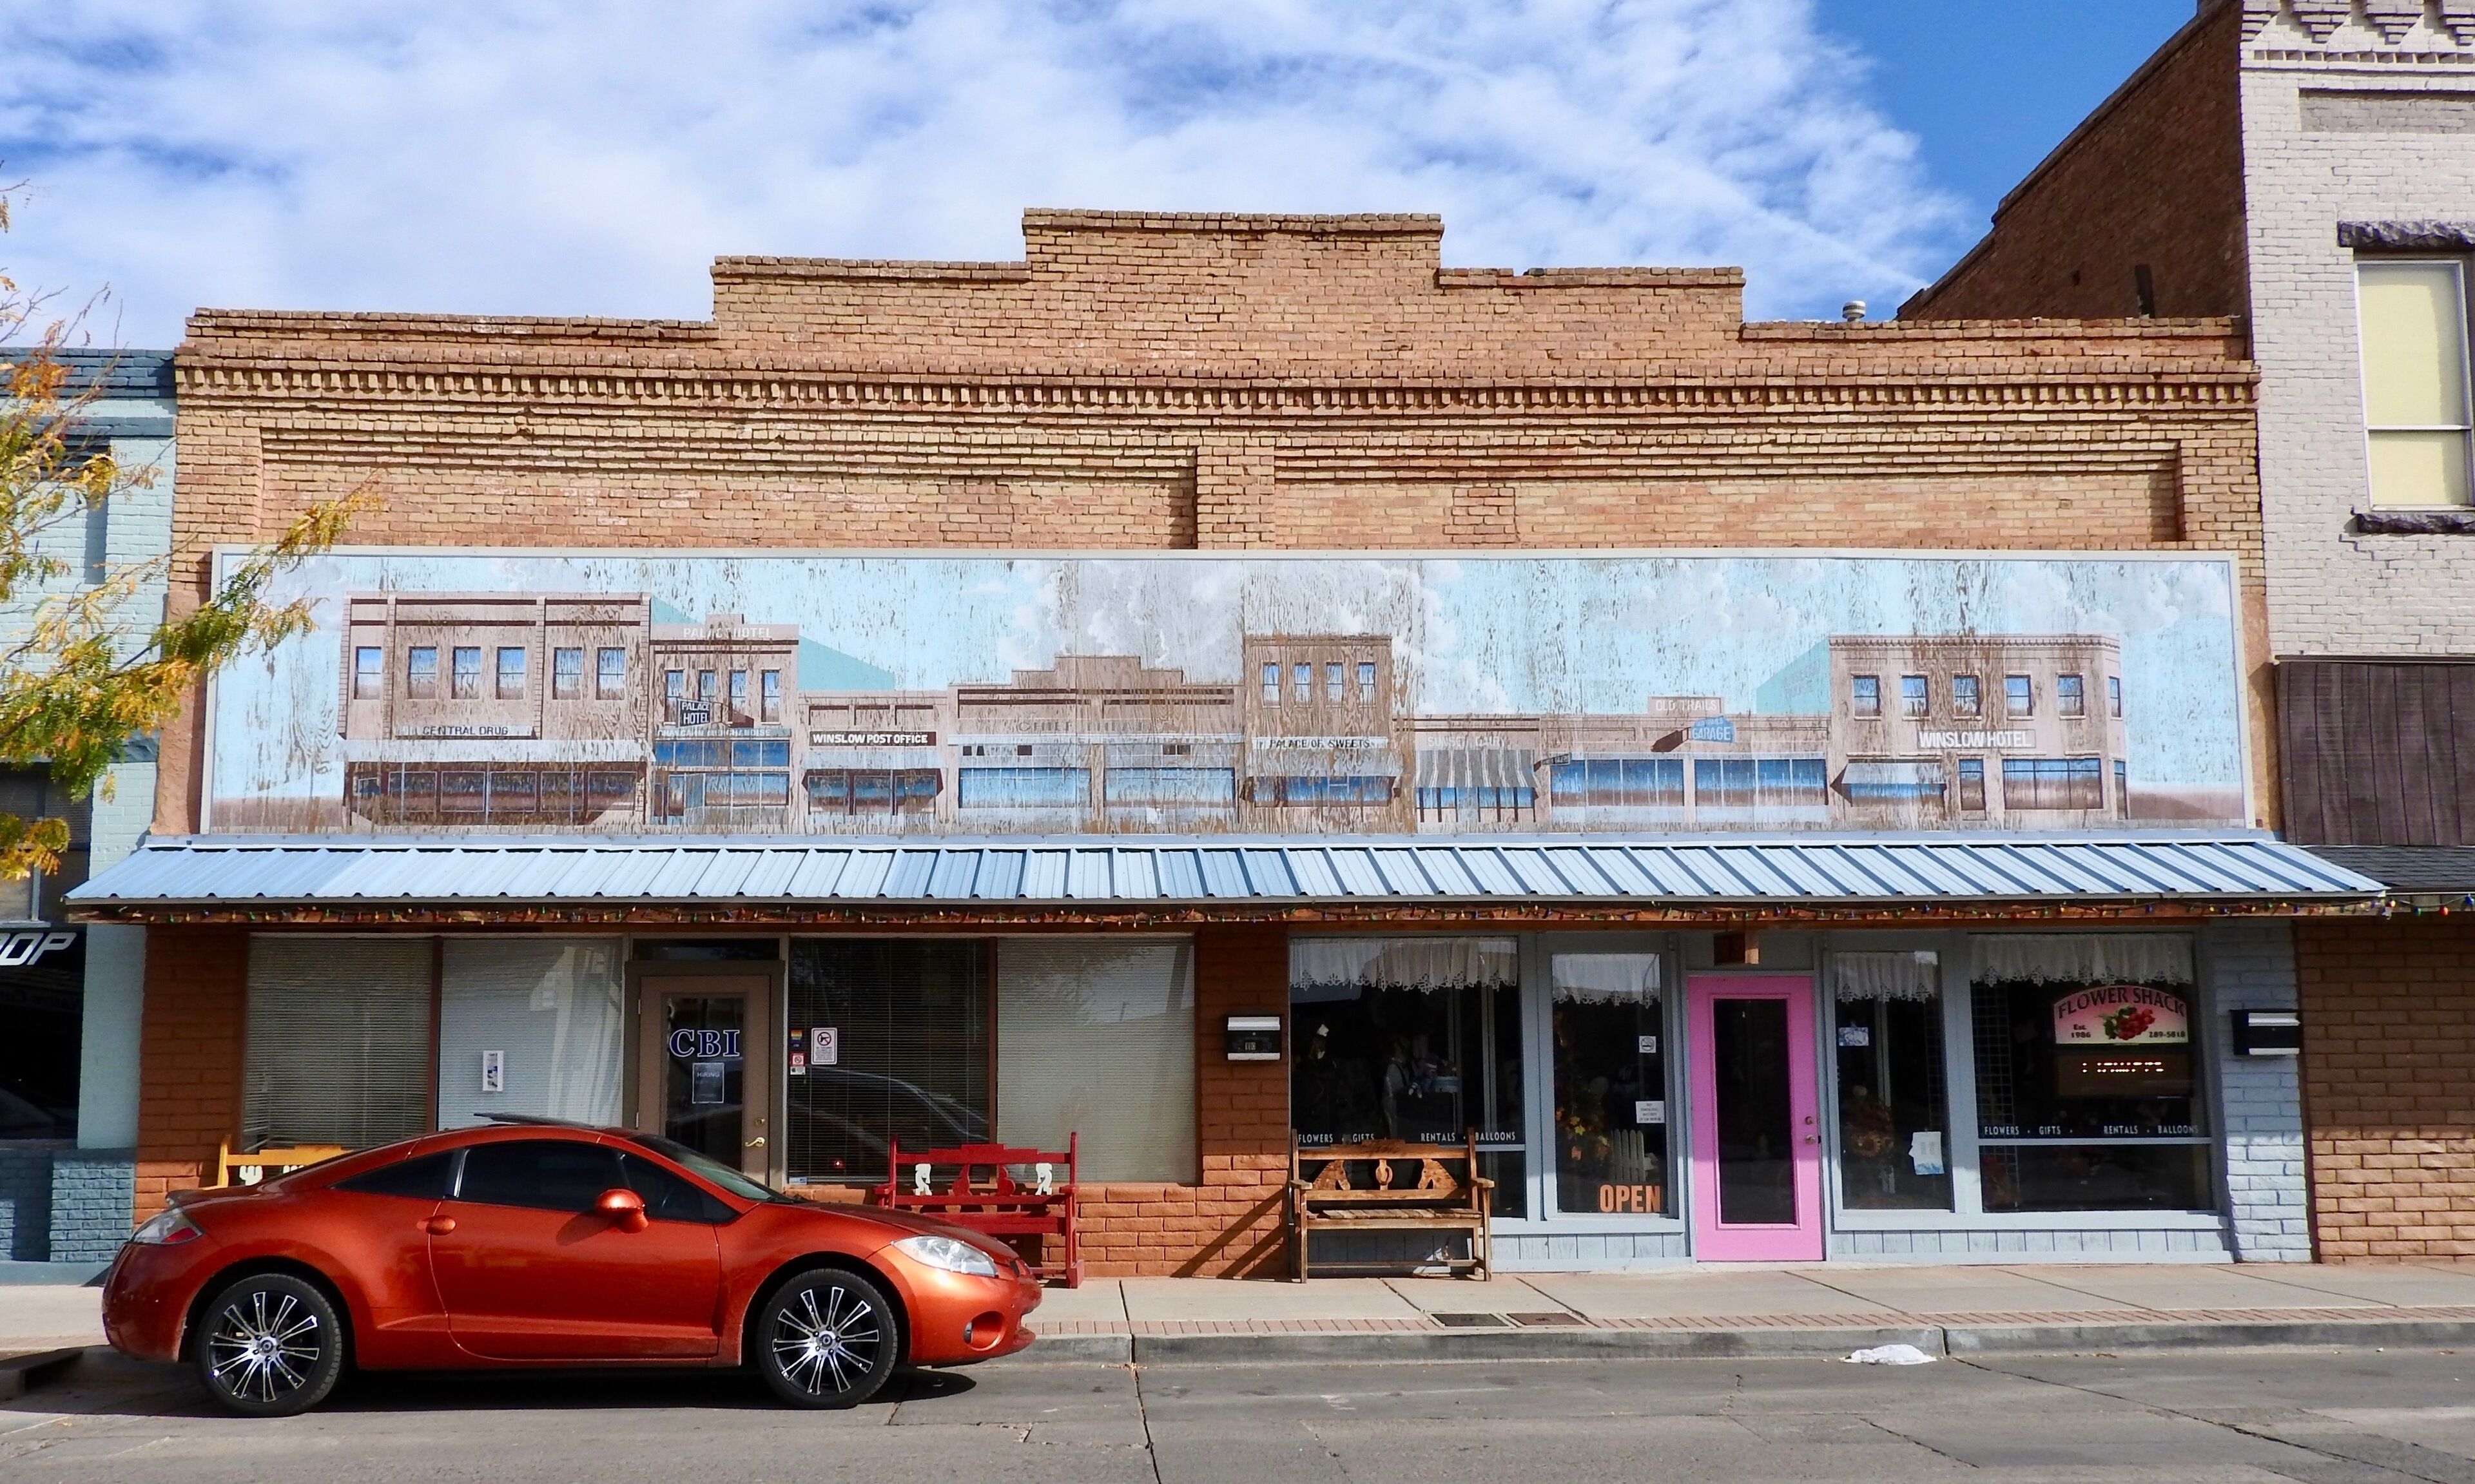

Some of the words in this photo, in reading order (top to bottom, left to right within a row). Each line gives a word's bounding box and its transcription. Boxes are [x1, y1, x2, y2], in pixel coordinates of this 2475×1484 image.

[733, 628, 773, 638] HOTEL
[681, 702, 710, 711] PALACE
[1655, 700, 1676, 711] OLD
[1681, 699, 1717, 711] TRAILS
[683, 712, 709, 725] HOTEL
[422, 726, 476, 735] CENTRAL
[479, 726, 509, 735] DRUG
[1692, 726, 1731, 741] GARAGE
[813, 734, 866, 744] WINSLOW
[867, 734, 893, 744] POST
[893, 734, 928, 744] OFFICE
[1270, 739, 1307, 748] PALACE
[1327, 739, 1370, 748] SWEETS
[1919, 730, 1985, 748] WINSLOW
[1987, 730, 2033, 747] HOTEL
[2059, 987, 2128, 1019] FLOWER
[2133, 987, 2186, 1017] SHACK
[669, 1028, 741, 1057] CBI
[1984, 1126, 2019, 1135] FLOWERS
[2039, 1126, 2061, 1135] GIFTS
[2103, 1125, 2138, 1135] RENTALS
[2157, 1125, 2198, 1134] BALLOONS
[1298, 1133, 1334, 1143] FLOWERS
[1421, 1132, 1456, 1142] RENTALS
[1475, 1132, 1516, 1141] BALLOONS
[1600, 1184, 1661, 1213] OPEN
